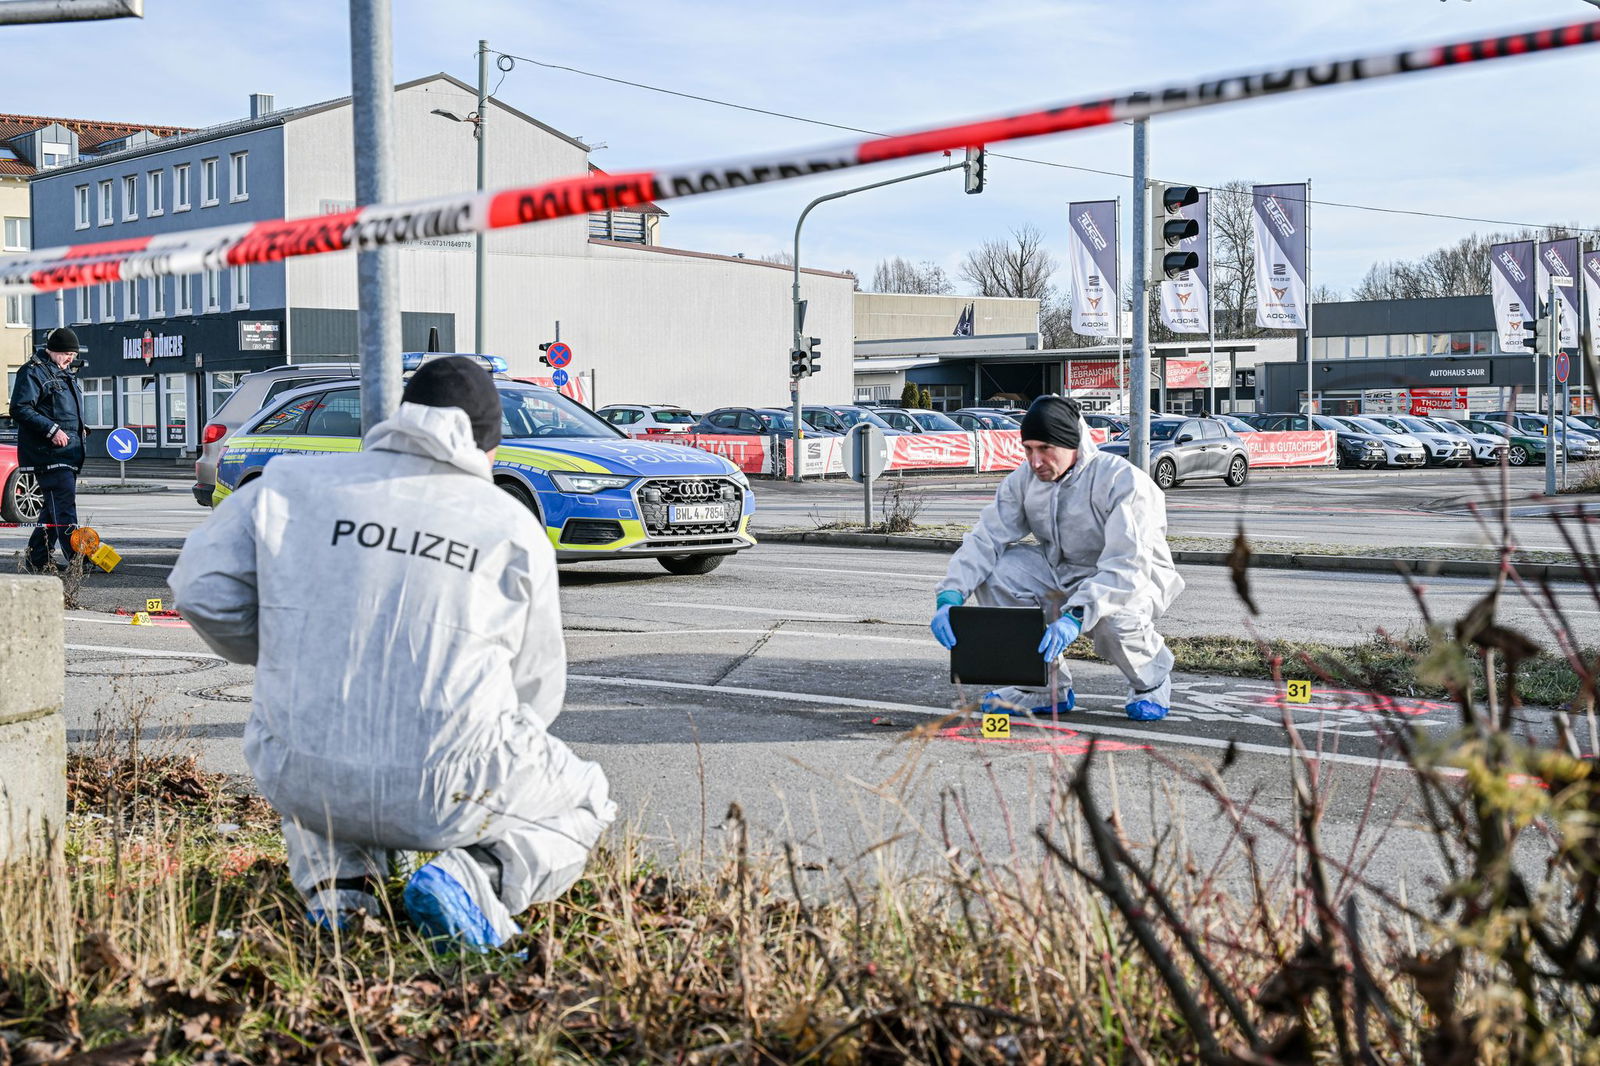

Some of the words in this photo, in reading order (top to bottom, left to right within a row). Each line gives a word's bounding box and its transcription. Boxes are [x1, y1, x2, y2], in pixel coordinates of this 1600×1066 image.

[1430, 369, 1466, 377] AUTOHAUS
[1467, 368, 1485, 376] SAUR
[1277, 440, 1321, 452] GUTACHTEN
[621, 453, 717, 466] POLIZEI
[676, 507, 693, 520] BWL
[330, 519, 480, 573] POLIZEI
[148, 601, 160, 609] 37
[1288, 683, 1307, 698] 31
[986, 717, 1009, 733] 32
